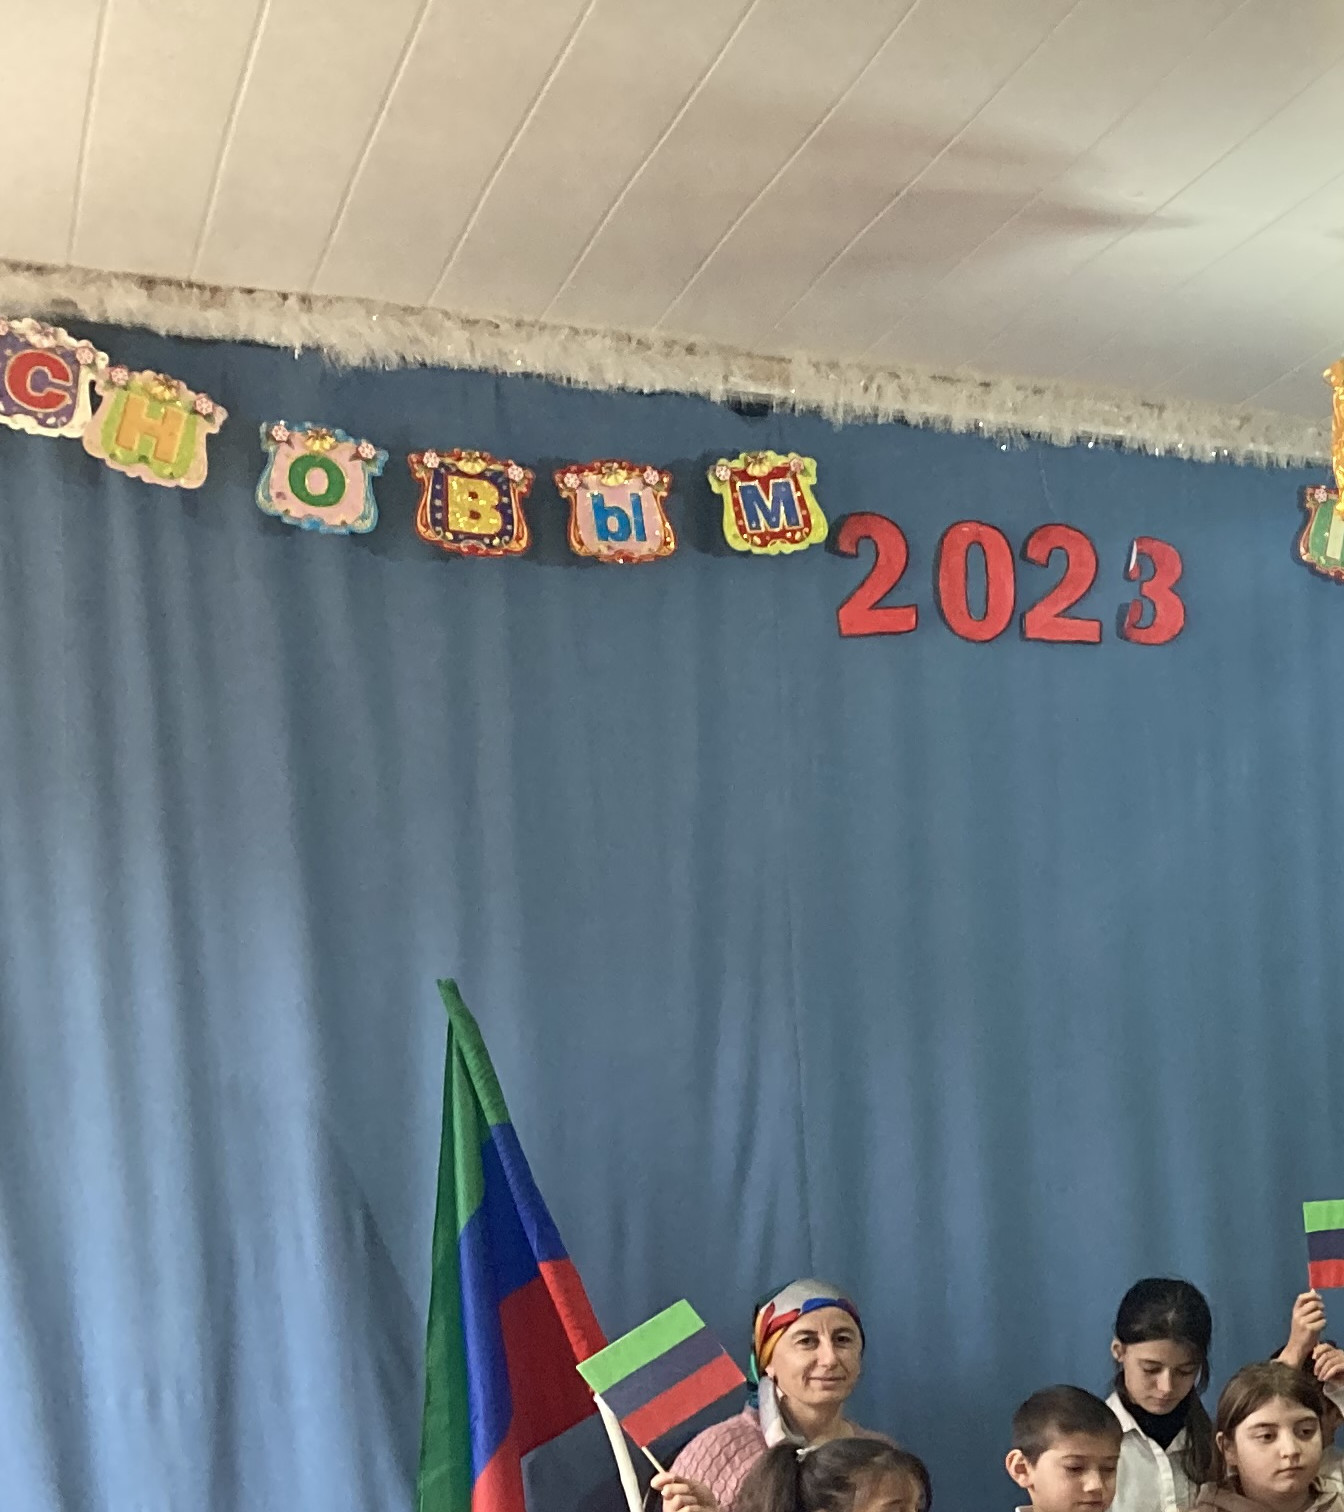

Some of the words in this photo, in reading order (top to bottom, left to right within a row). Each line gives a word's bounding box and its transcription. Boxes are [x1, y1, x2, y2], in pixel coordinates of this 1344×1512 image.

[5, 350, 71, 412] С
[113, 393, 803, 544] НОВЫМ
[836, 510, 1187, 646] 2023
